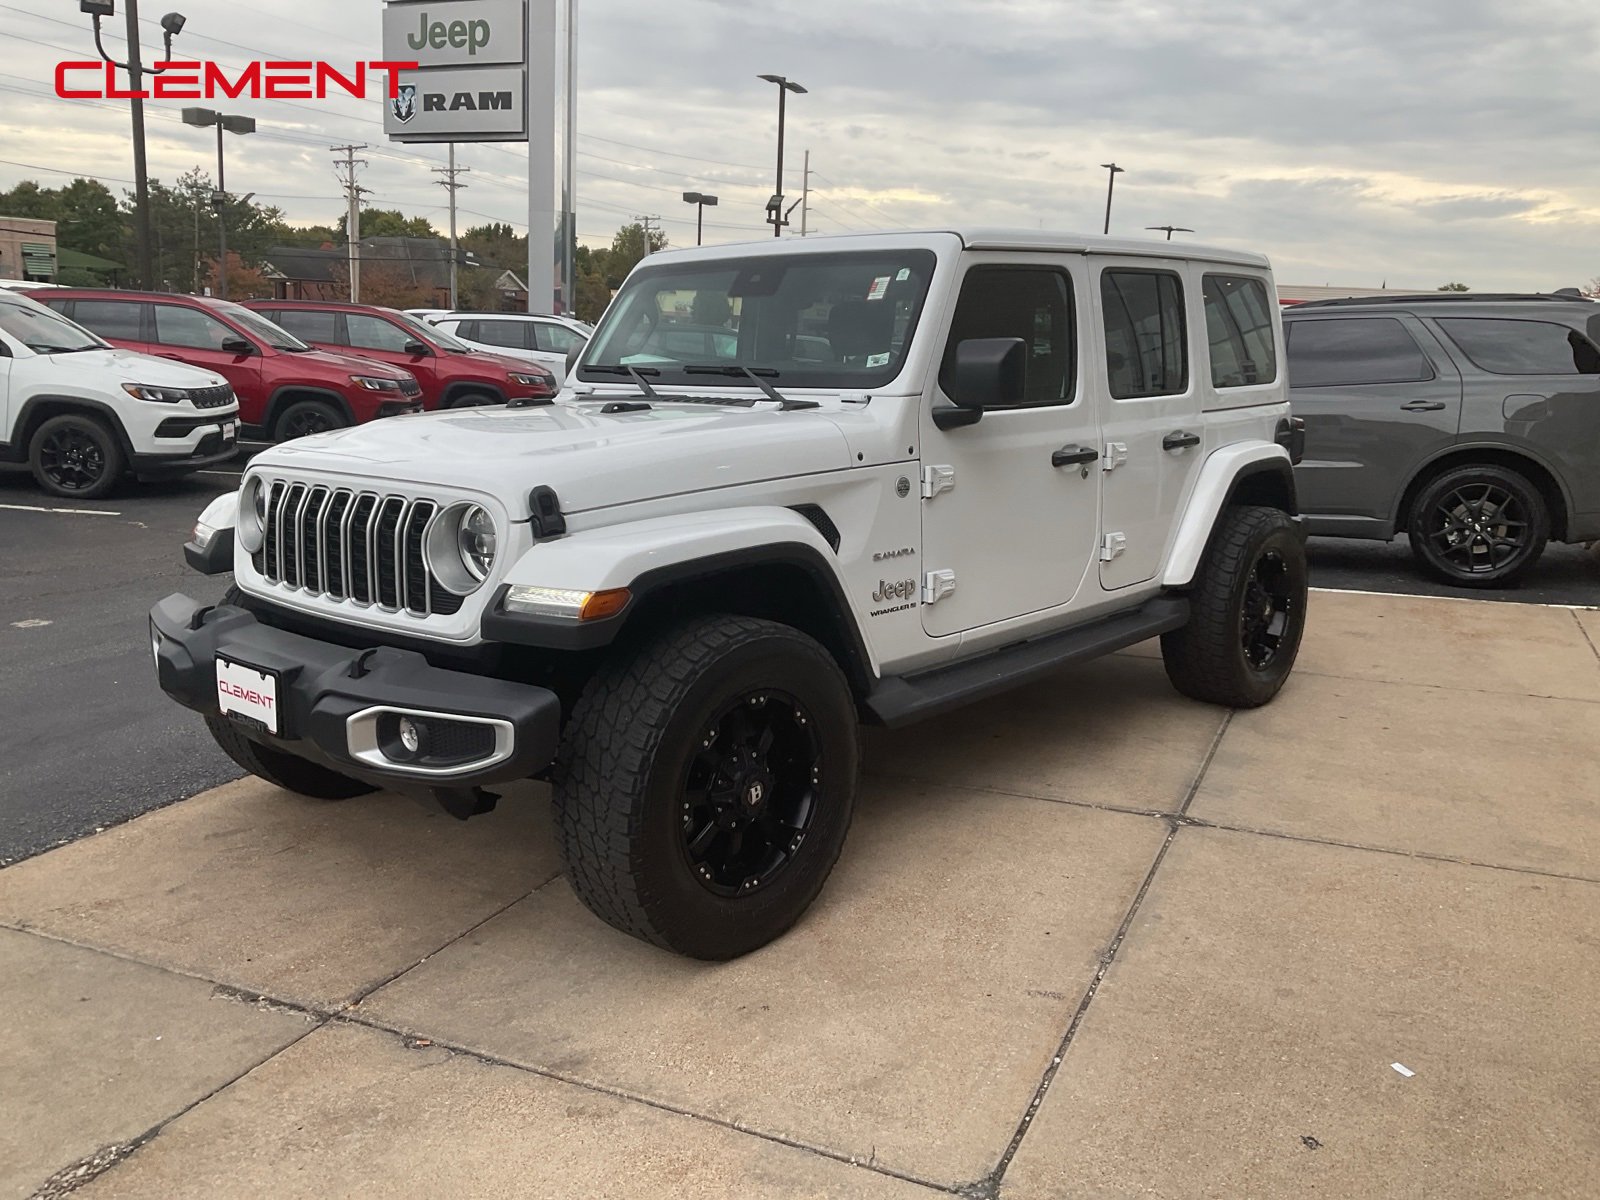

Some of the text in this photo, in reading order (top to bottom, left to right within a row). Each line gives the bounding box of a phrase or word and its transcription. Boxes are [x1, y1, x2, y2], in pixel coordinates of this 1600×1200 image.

[407, 13, 490, 55] Jeep
[423, 92, 512, 111] RAM
[873, 547, 915, 562] SAHARA
[872, 579, 915, 602] Jeep
[870, 604, 909, 617] WRANGLER
[219, 681, 273, 709] CLEMENT
